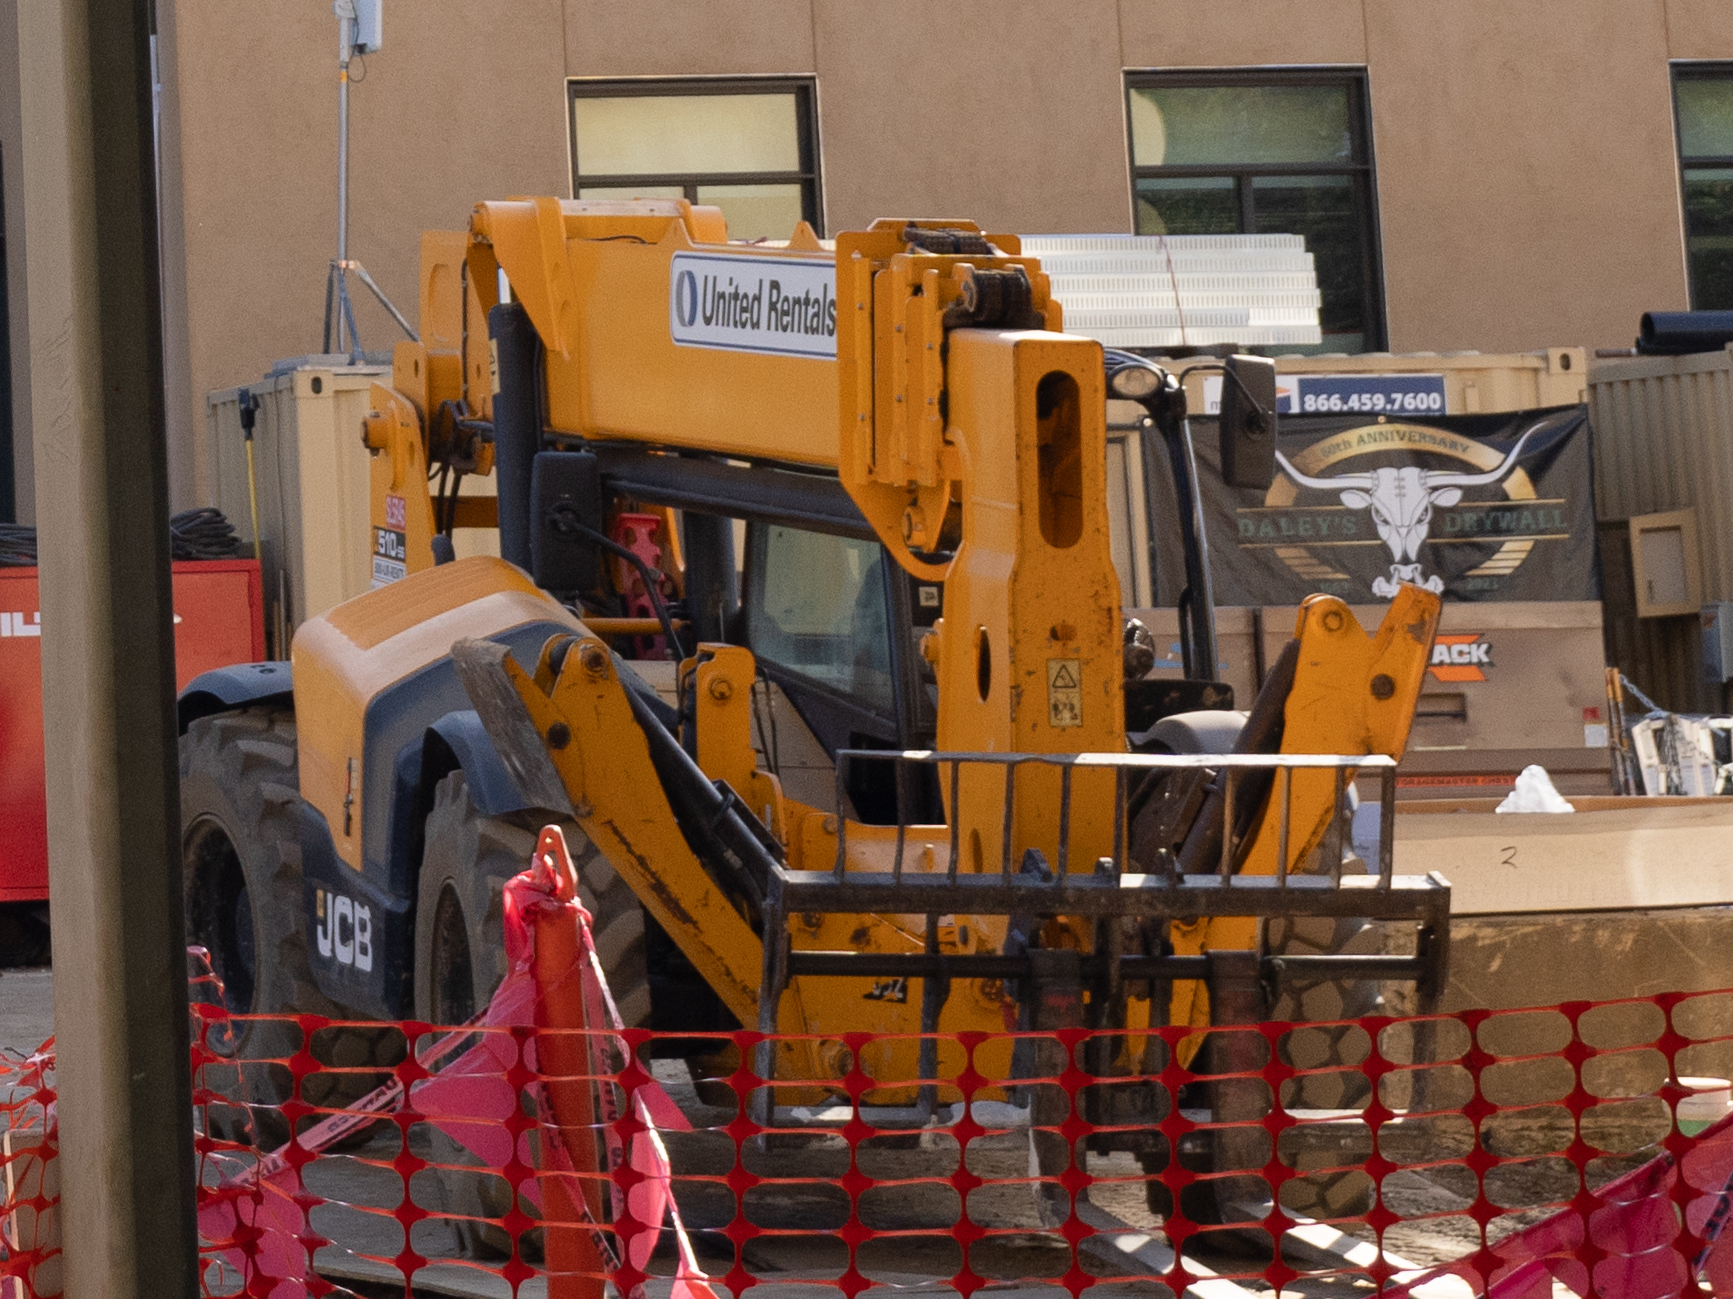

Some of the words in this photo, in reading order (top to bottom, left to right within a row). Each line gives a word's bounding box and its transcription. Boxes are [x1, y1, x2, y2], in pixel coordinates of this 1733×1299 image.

[702, 274, 763, 330] United
[766, 279, 837, 337] Rentals
[1303, 392, 1442, 413] 866.459.7600
[1357, 429, 1470, 454] ANNIVERSARY
[1238, 516, 1358, 538] DALEY'S
[1444, 510, 1568, 533] DRYWALL
[1432, 643, 1490, 664] ACK
[316, 889, 372, 972] JCB
